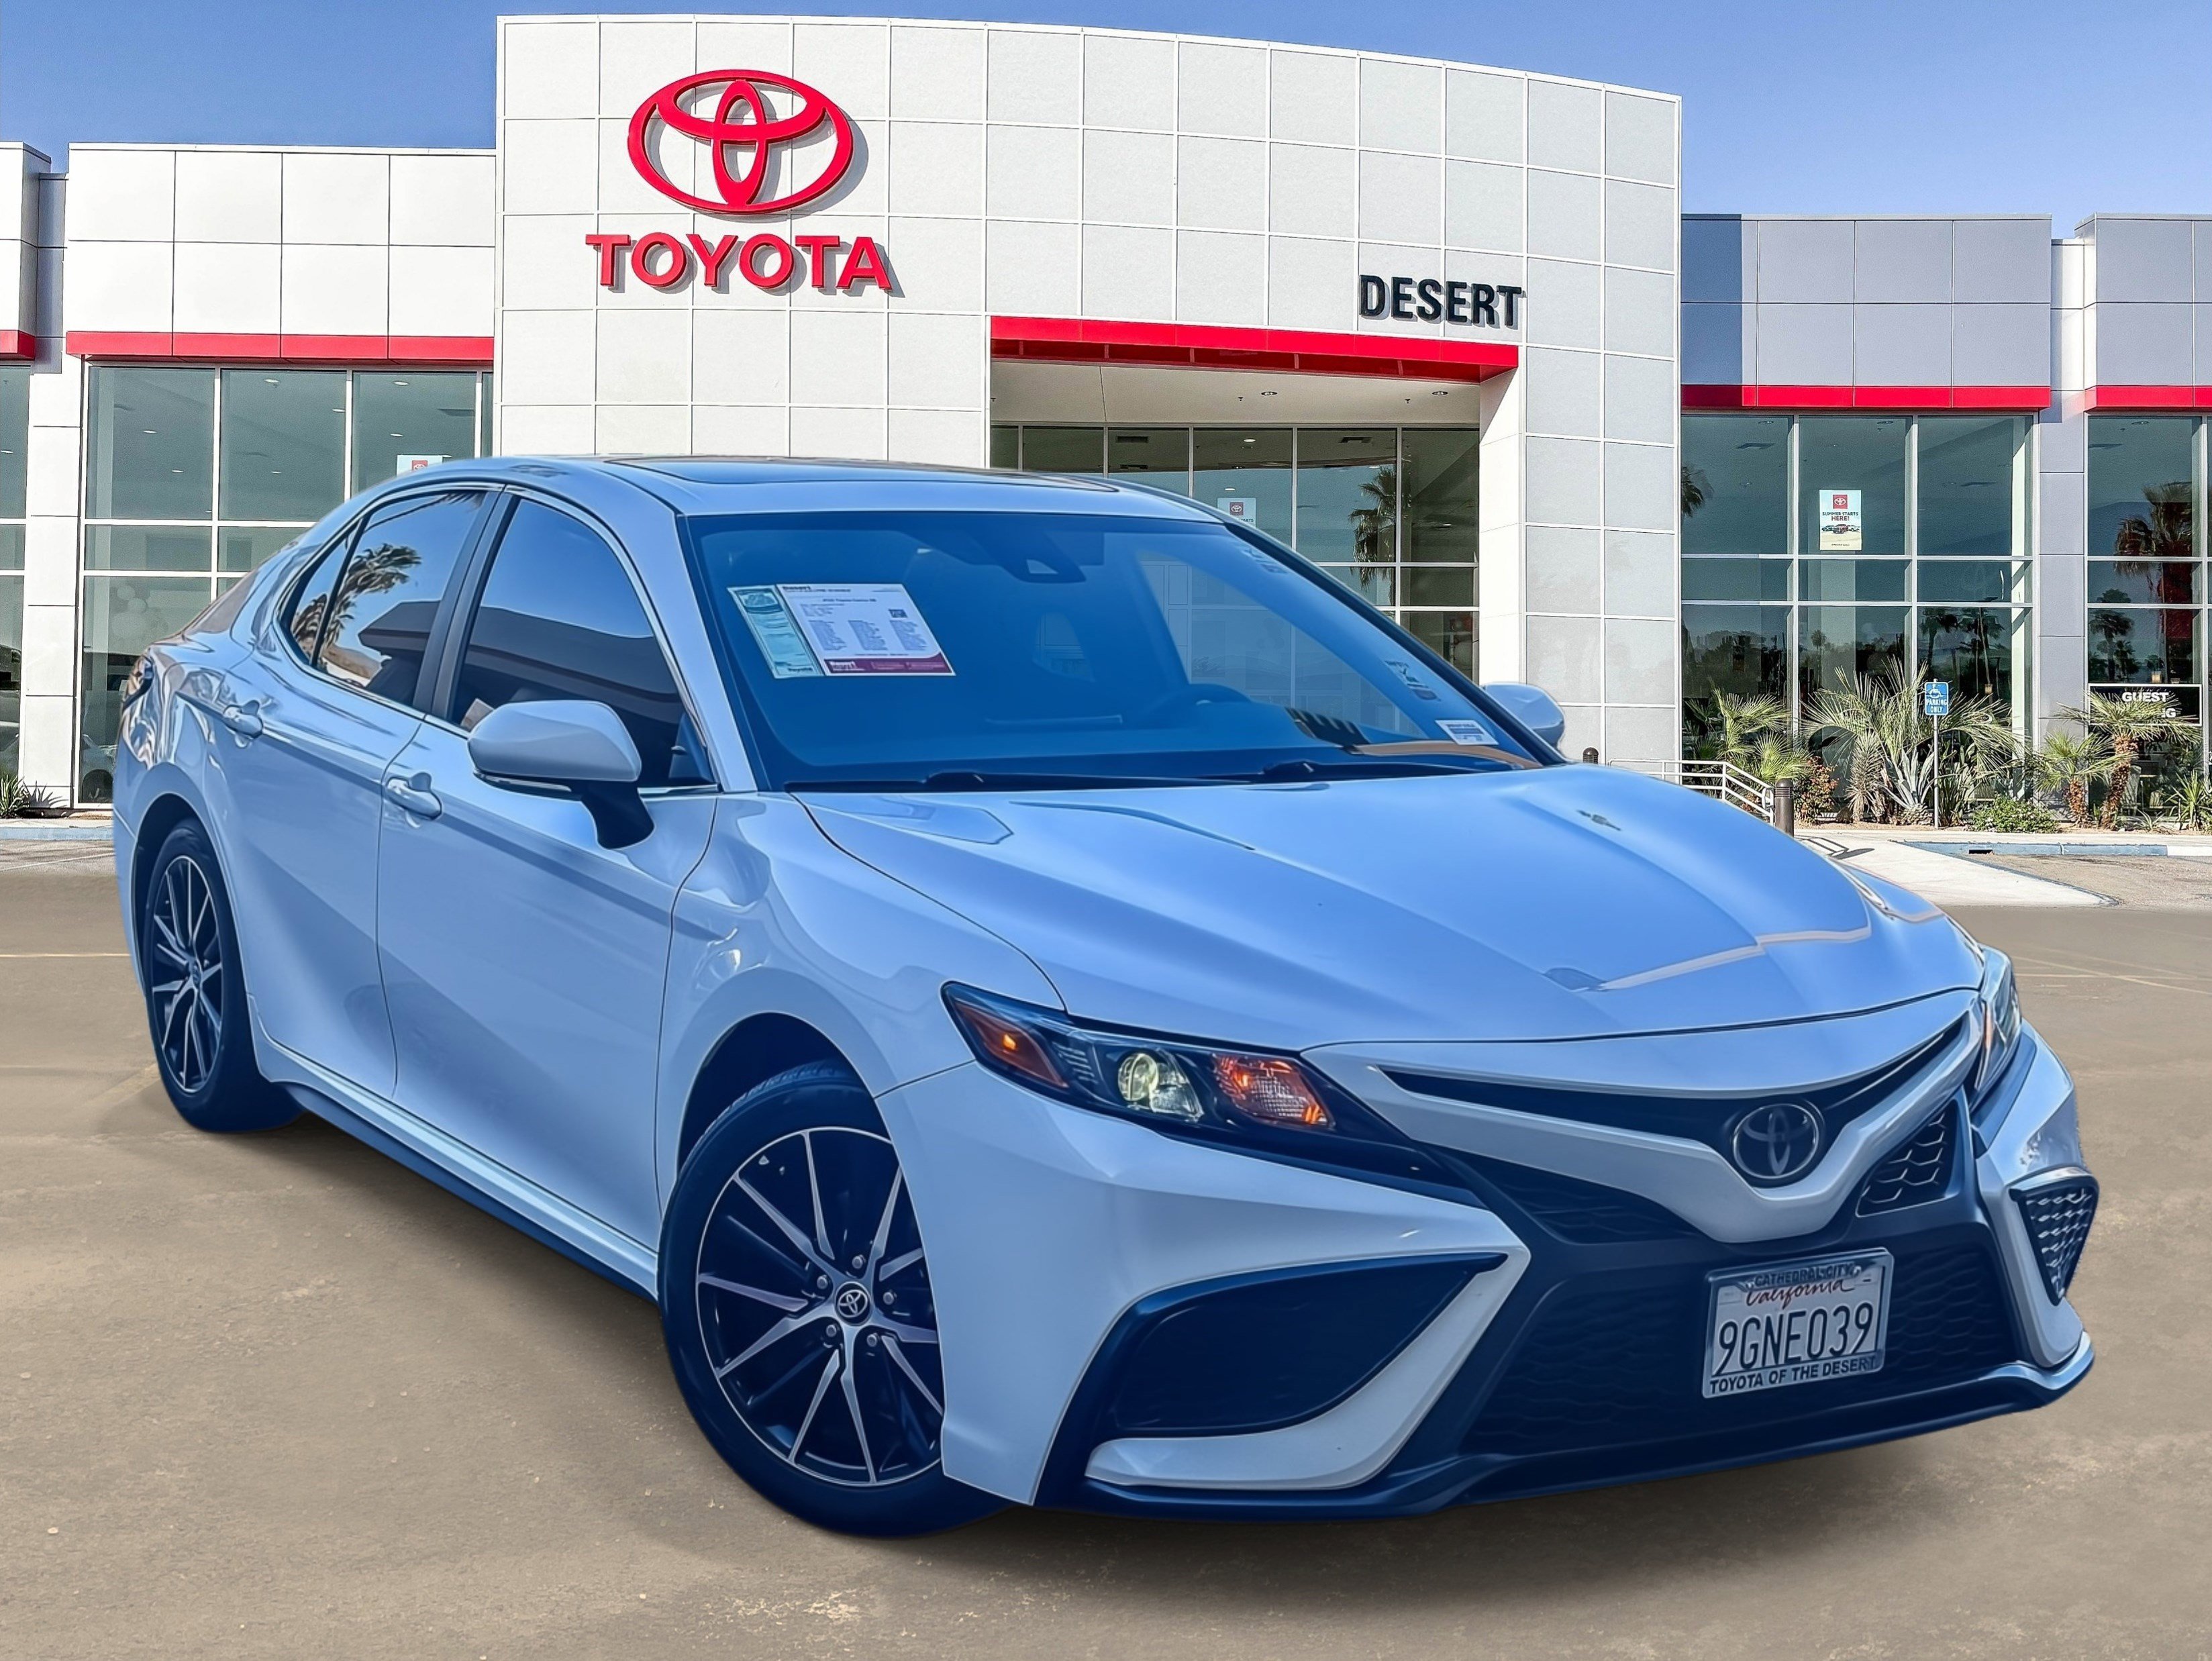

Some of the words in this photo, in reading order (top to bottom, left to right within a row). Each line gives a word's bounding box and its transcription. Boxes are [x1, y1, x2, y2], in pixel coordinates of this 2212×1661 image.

[585, 232, 893, 290] TOYOTA
[1359, 274, 1522, 326] DESERT
[1926, 698, 1947, 706] PARKING
[2121, 692, 2169, 702] GUEST
[1754, 1266, 1822, 1287] CATHEDRAL
[1825, 1263, 1854, 1278] CITY
[1746, 1278, 1855, 1309] California
[1712, 1302, 1874, 1376] 9GNE039
[1709, 1373, 1763, 1395] TOYOTA
[1768, 1369, 1787, 1385] OF
[1792, 1364, 1819, 1380] THE
[1822, 1356, 1876, 1374] DESERT
